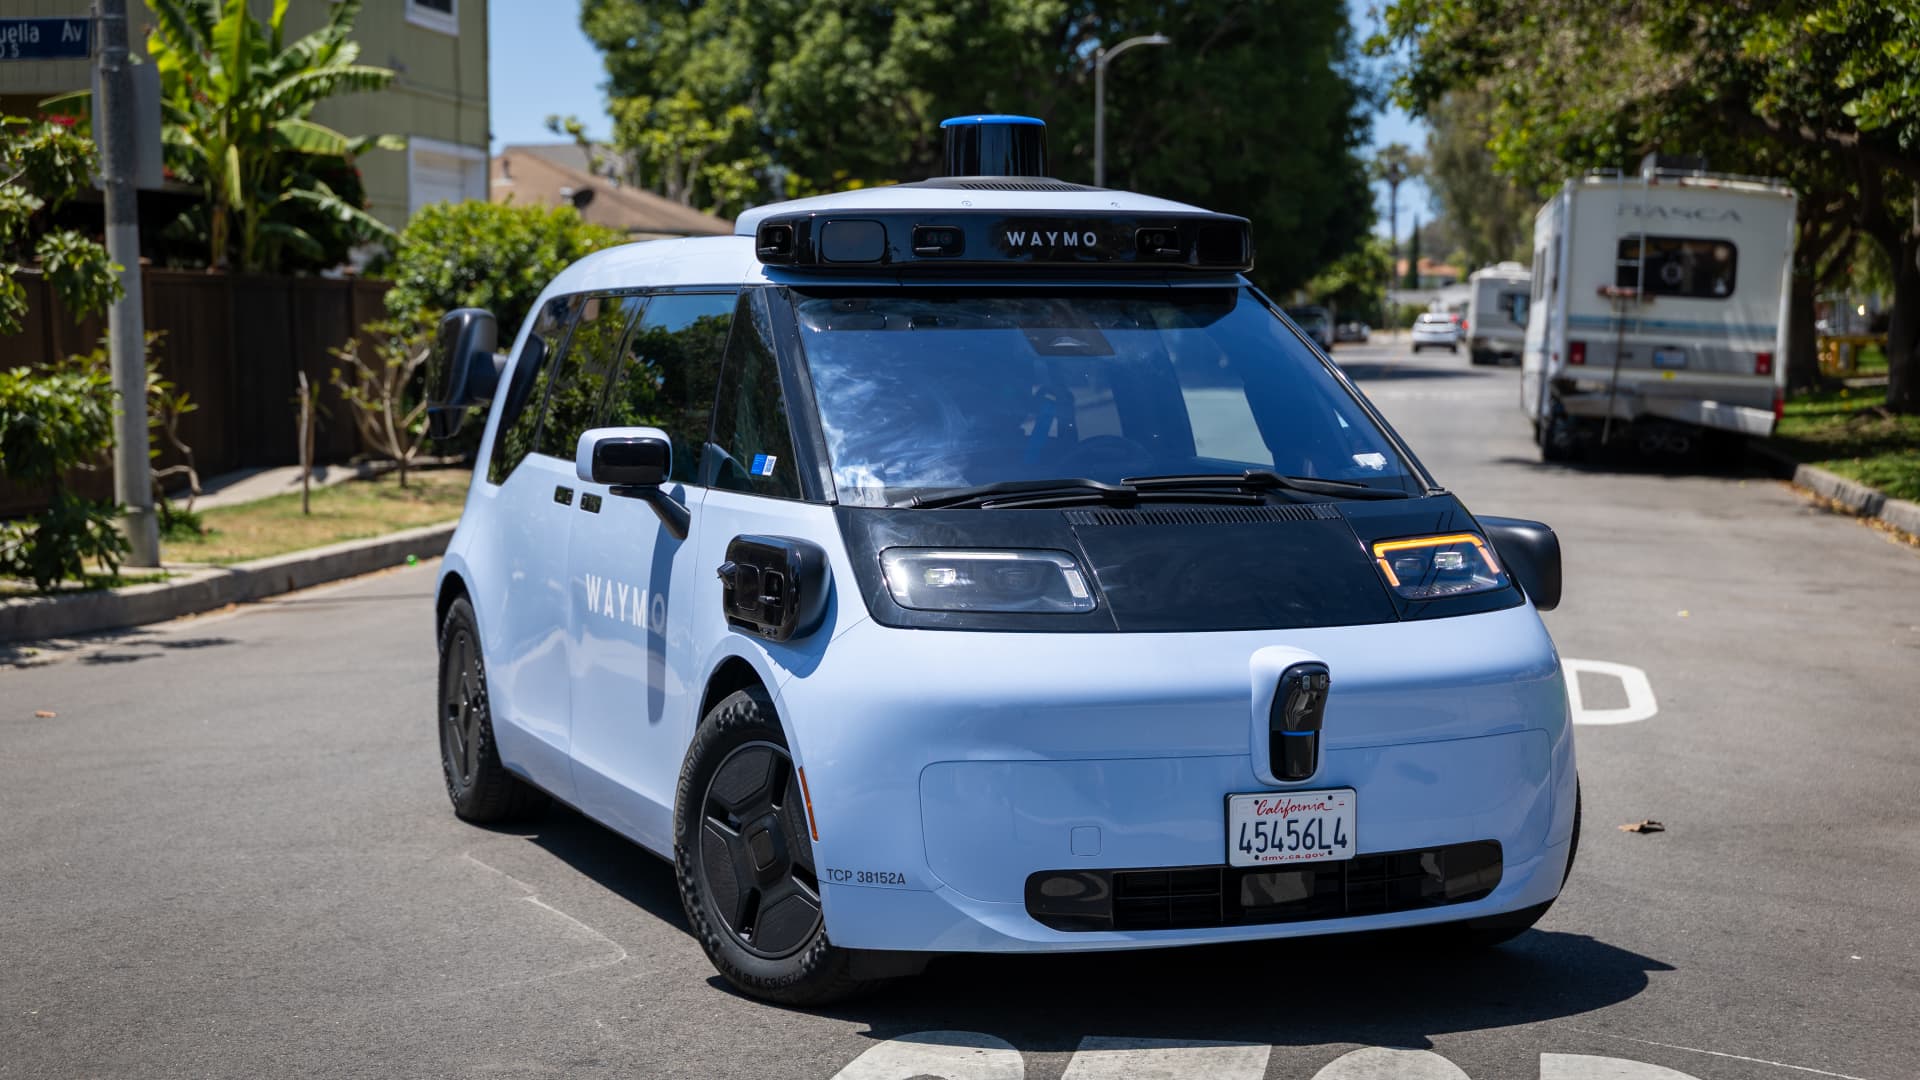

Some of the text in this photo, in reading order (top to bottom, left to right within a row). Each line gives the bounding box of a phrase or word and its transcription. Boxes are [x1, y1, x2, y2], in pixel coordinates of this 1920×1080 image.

[61, 20, 83, 42] Av
[1006, 231, 1097, 247] WAYMO
[585, 572, 666, 635] WAYMO
[1256, 799, 1333, 819] California
[1238, 817, 1348, 854] 45456L4
[1261, 852, 1325, 861] dmv.ca.gov
[826, 868, 906, 885] TCP 38152A
